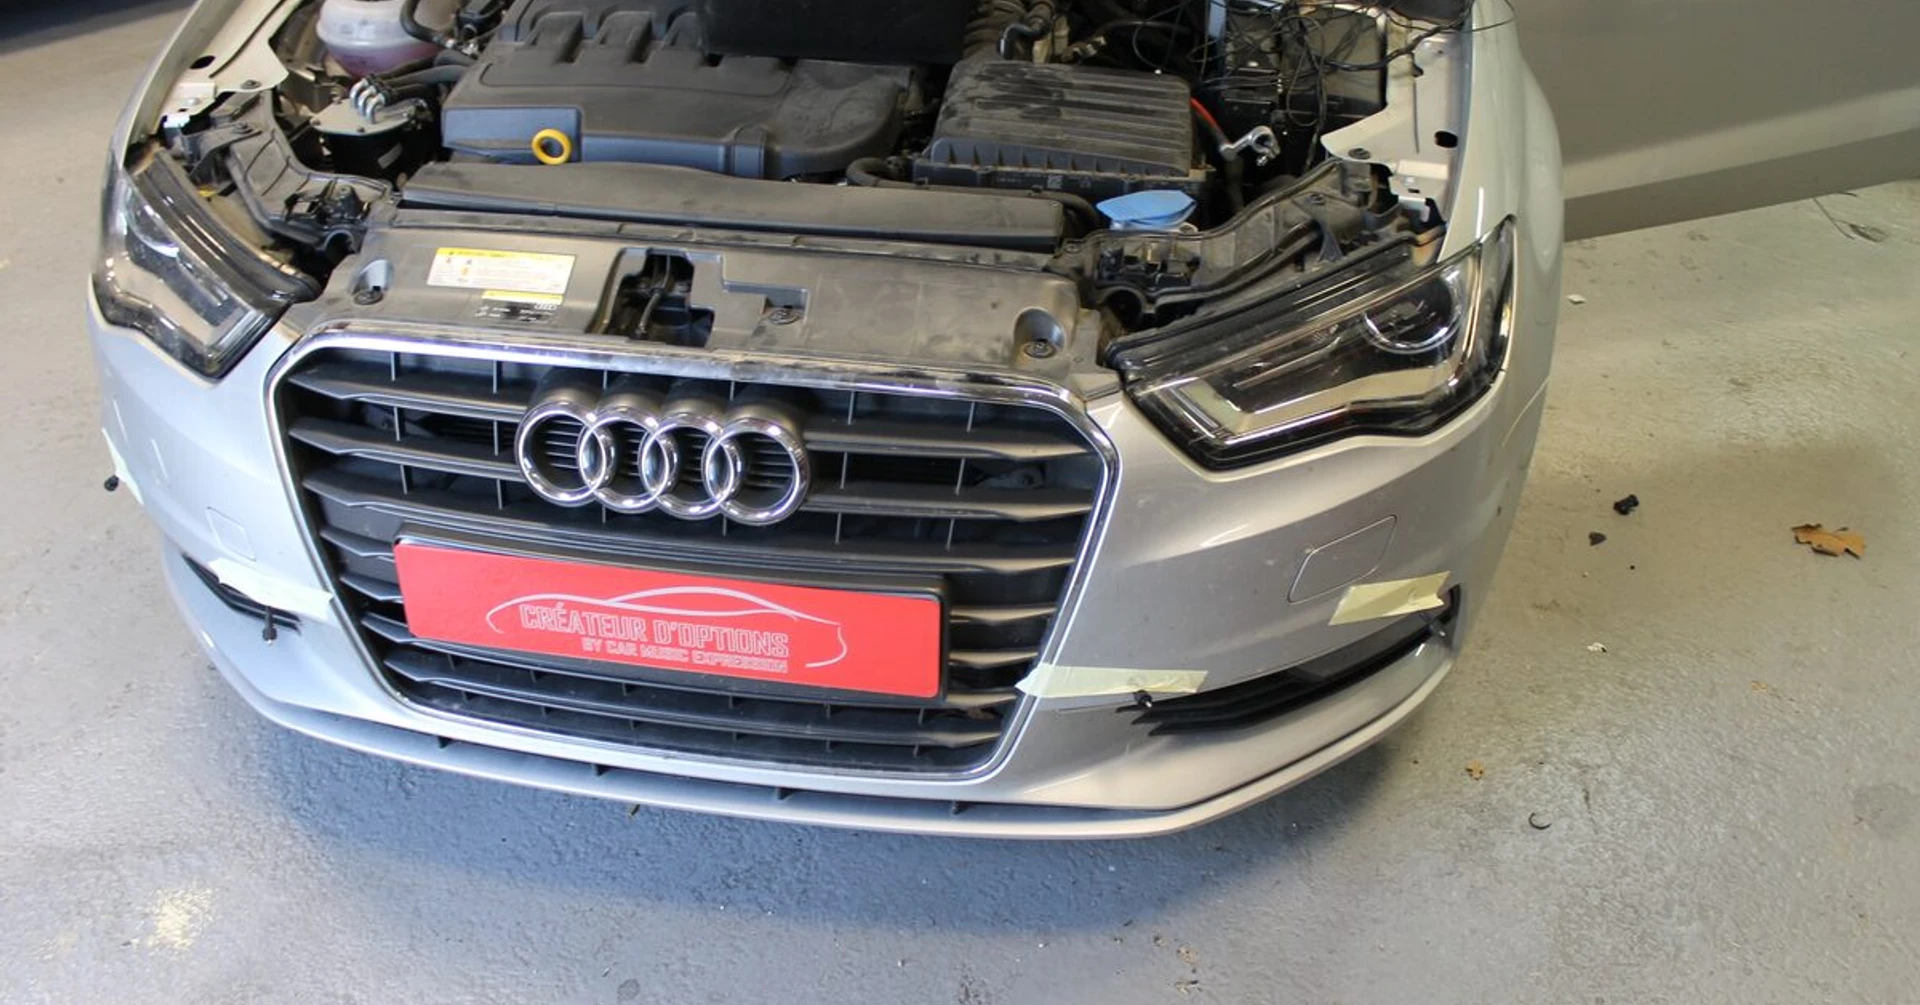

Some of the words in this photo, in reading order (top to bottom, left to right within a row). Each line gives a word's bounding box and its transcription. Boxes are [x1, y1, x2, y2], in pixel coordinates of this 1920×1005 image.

[518, 601, 648, 642] CRÉATEUR
[653, 619, 789, 658] D'OPTIONS
[581, 637, 603, 653] BY
[605, 640, 638, 657] CAR
[640, 644, 689, 662] MUSIC
[691, 649, 788, 674] EXPRESSION
